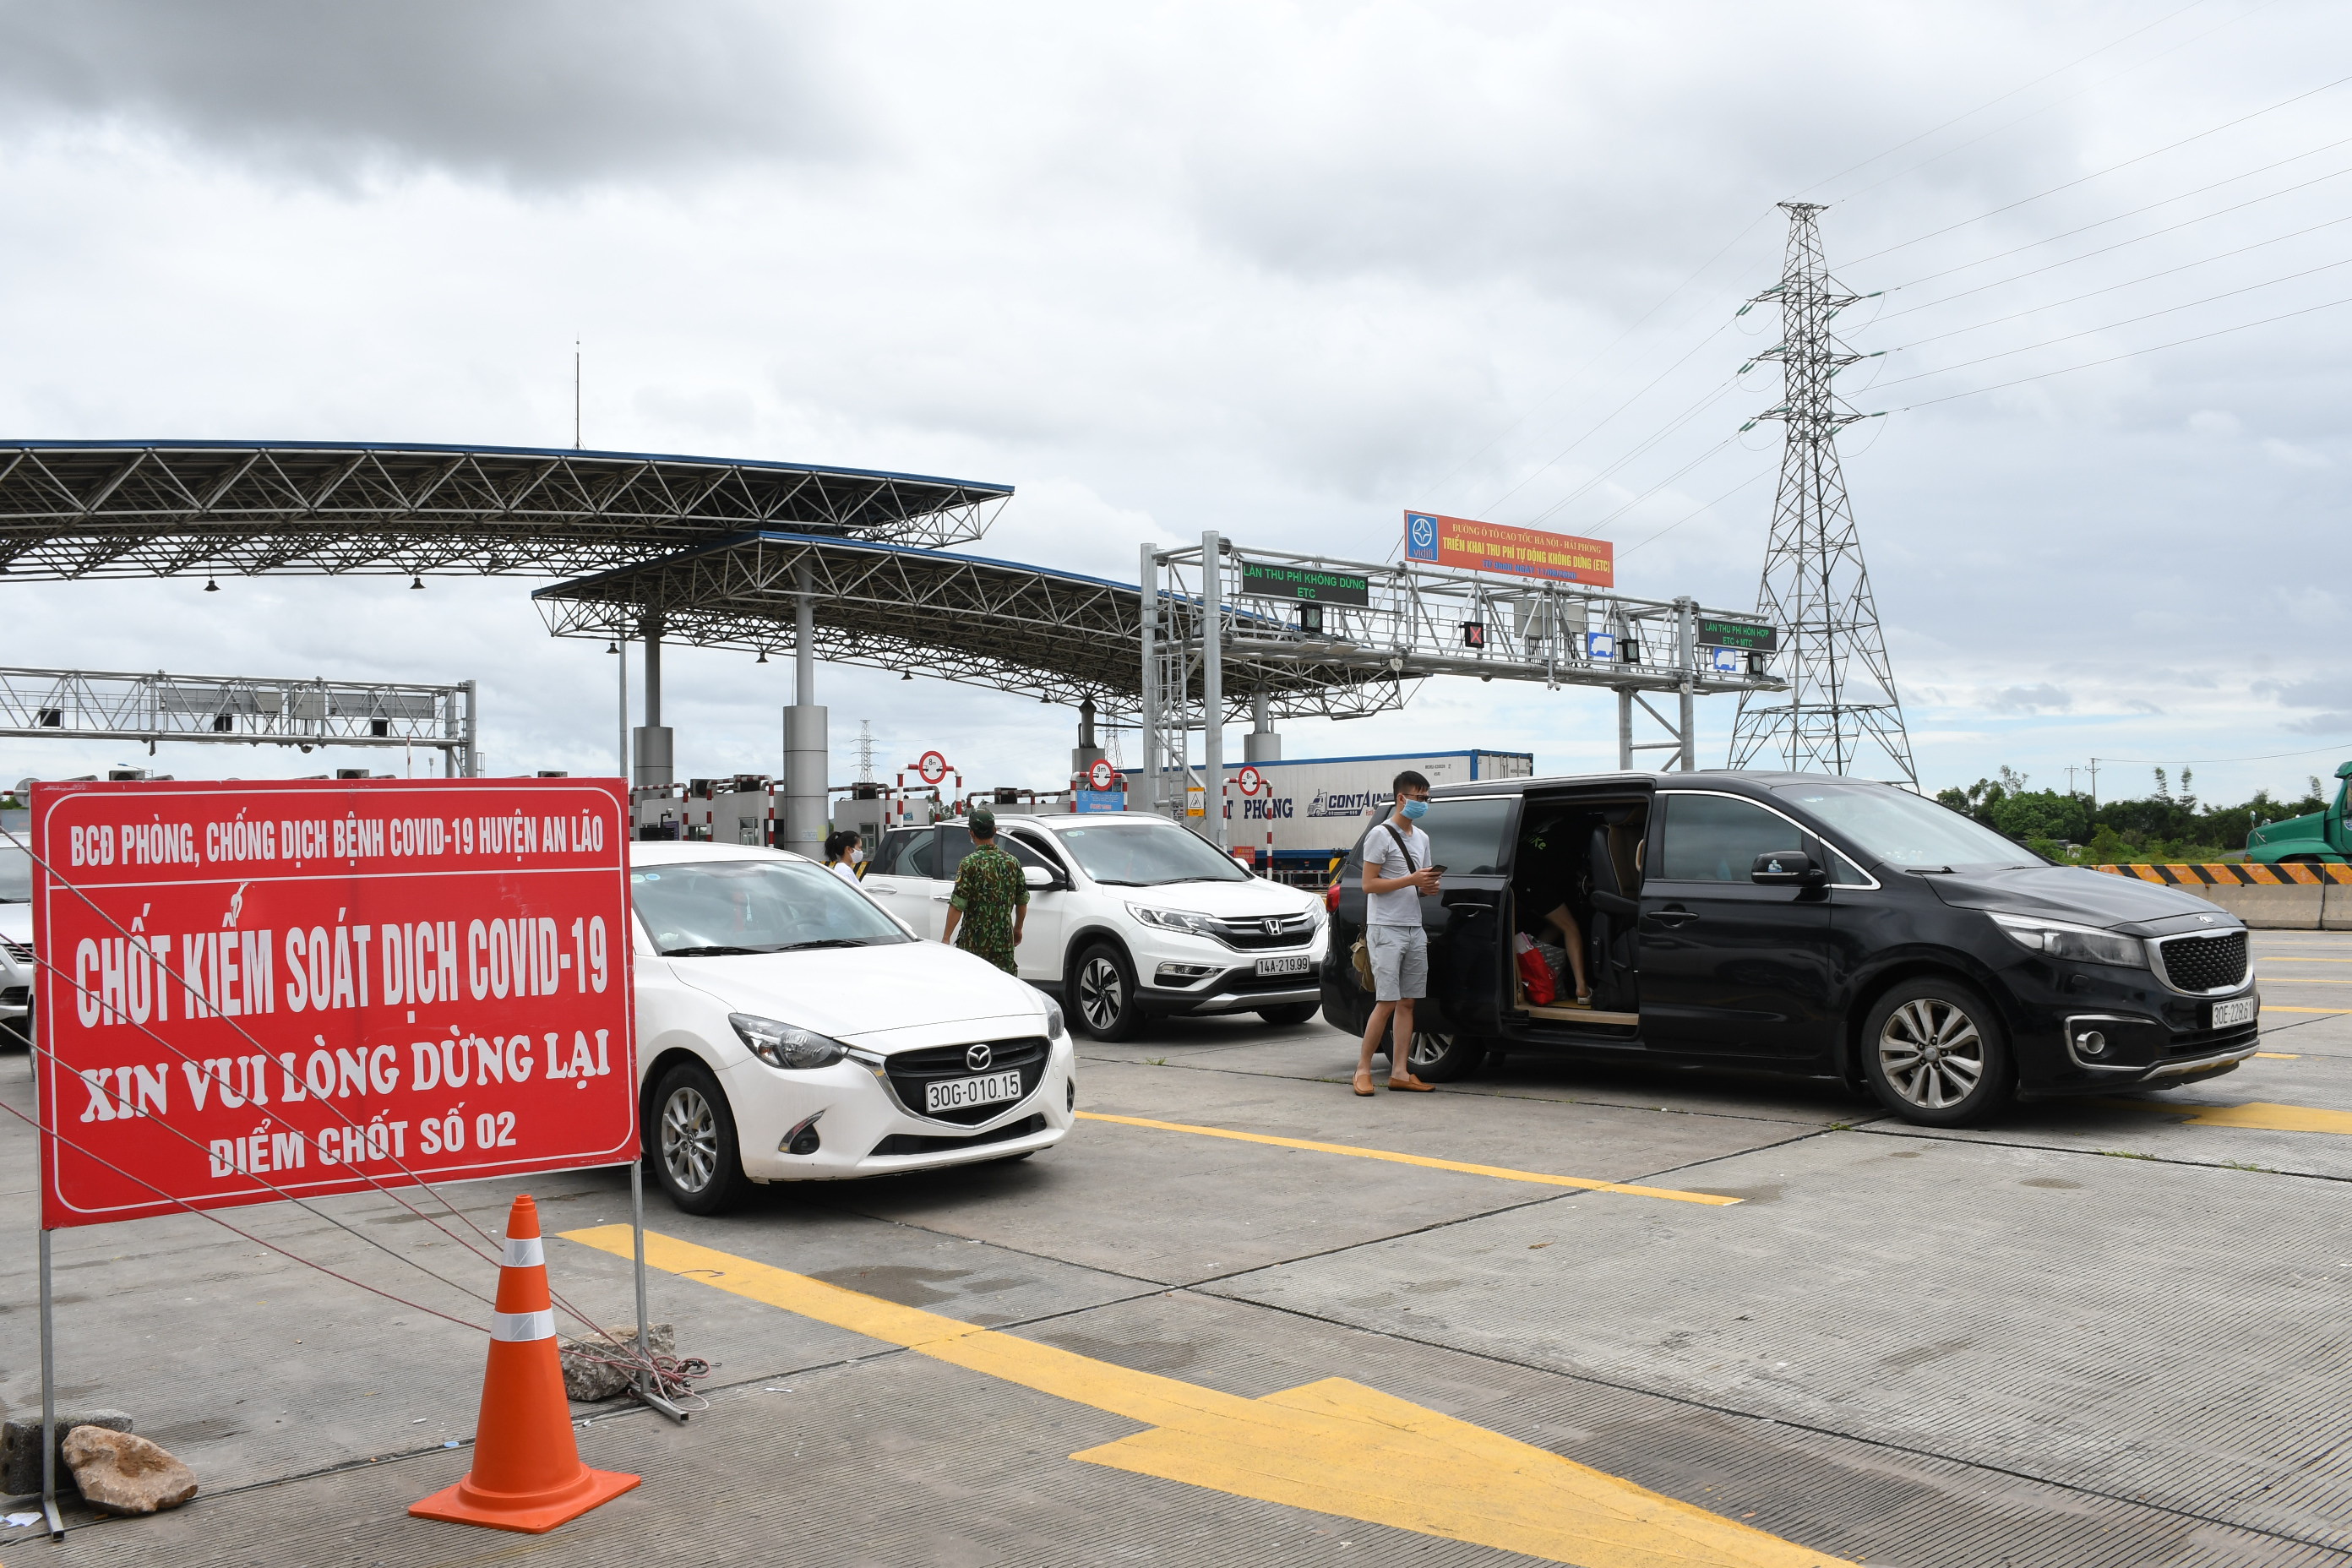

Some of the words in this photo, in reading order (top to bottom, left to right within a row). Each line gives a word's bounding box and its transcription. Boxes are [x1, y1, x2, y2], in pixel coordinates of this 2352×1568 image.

[1452, 523, 1479, 536] ĐƯỜNG
[1500, 531, 1516, 541] CAO
[1518, 531, 1533, 543] TỐC
[1534, 535, 1544, 545] HÀ
[1546, 537, 1559, 549] NỘI
[1443, 534, 1465, 552] TRIỂN
[1467, 541, 1484, 554] KHAI
[1487, 543, 1500, 556] THU
[1502, 545, 1515, 558] PHÍ
[1516, 547, 1526, 563] TỰ
[1527, 547, 1546, 564] ĐỘNG
[1548, 551, 1571, 567] KHÔNG
[1573, 554, 1592, 569] DỪNG
[1593, 558, 1610, 573] (ETC)
[1243, 564, 1262, 578] LÀN
[1265, 569, 1284, 580] THU
[1288, 570, 1302, 583] PHÍ
[1304, 572, 1337, 586] KHÔNG
[1340, 576, 1365, 591] DỪNG
[1297, 587, 1315, 599] ETC
[1719, 624, 1730, 634] THU
[1723, 636, 1734, 645] ETC
[71, 825, 114, 867] BCĐ
[121, 813, 200, 868] PHÒNG,
[206, 807, 275, 862] CHỐNG
[281, 819, 328, 868] DỊCH
[333, 810, 384, 867] BỆNH
[389, 817, 474, 857] COVID-19
[479, 808, 537, 862] HUYỆN
[542, 816, 567, 852] AN
[571, 808, 603, 852] LÃO
[76, 902, 172, 1028] CHỐT
[286, 906, 372, 1013] SOÁT
[381, 921, 459, 1024] DỊCH
[468, 915, 608, 1001] COVID-19
[1259, 957, 1308, 973] 14A-219.99
[2213, 1000, 2252, 1026] 30E-228.61
[79, 1063, 169, 1123] XIN
[182, 1054, 269, 1112] VUI
[280, 1033, 400, 1103] LÒNG
[411, 1024, 534, 1092] DỪNG
[544, 1029, 611, 1090] LẠI
[929, 1074, 1019, 1108] 30G-010.15
[209, 1118, 305, 1179] ĐIỂM
[318, 1108, 408, 1166] CHỐT
[420, 1102, 466, 1155] SỐ
[476, 1111, 517, 1150] 02
